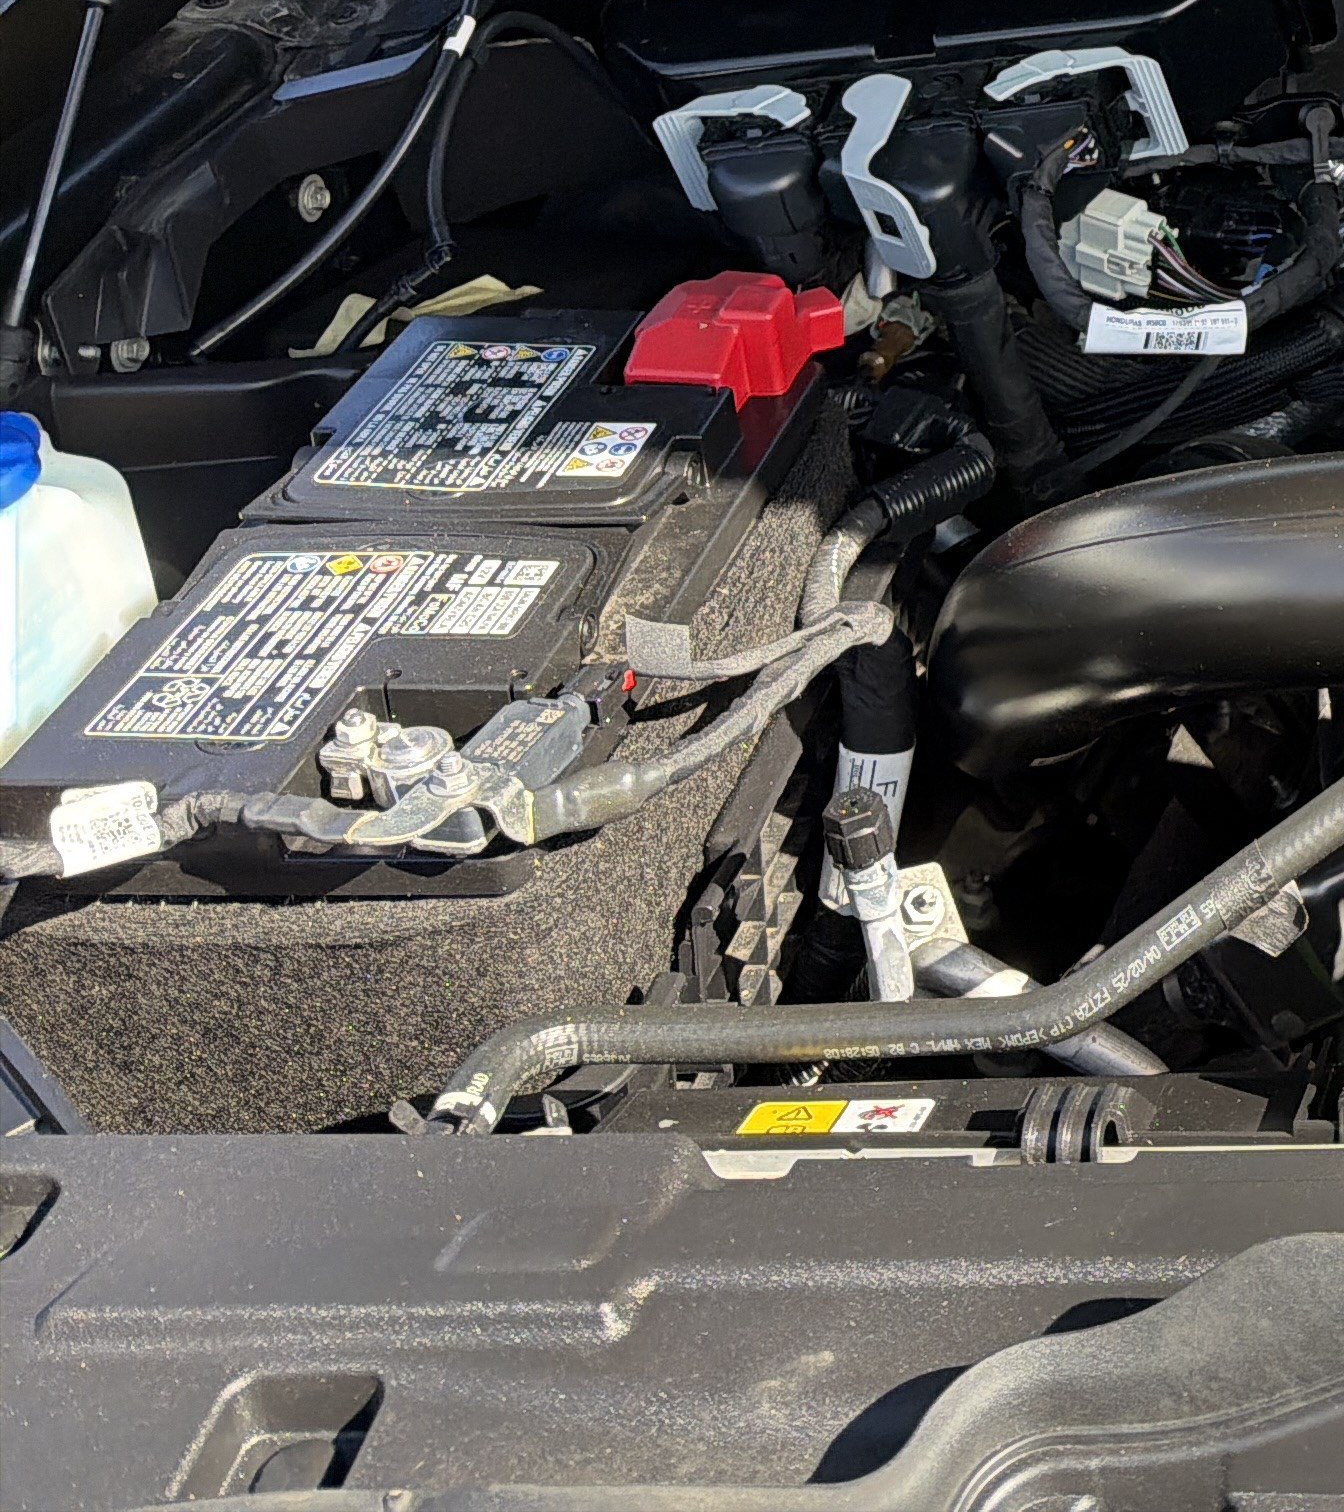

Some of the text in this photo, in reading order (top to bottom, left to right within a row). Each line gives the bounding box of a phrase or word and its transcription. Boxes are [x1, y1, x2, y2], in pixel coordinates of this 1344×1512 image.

[1111, 944, 1162, 993] 04/02/25
[886, 1042, 905, 1055] B2
[909, 1041, 920, 1054] C
[963, 1036, 992, 1051] MEX
[822, 1044, 881, 1060] 05:28:08
